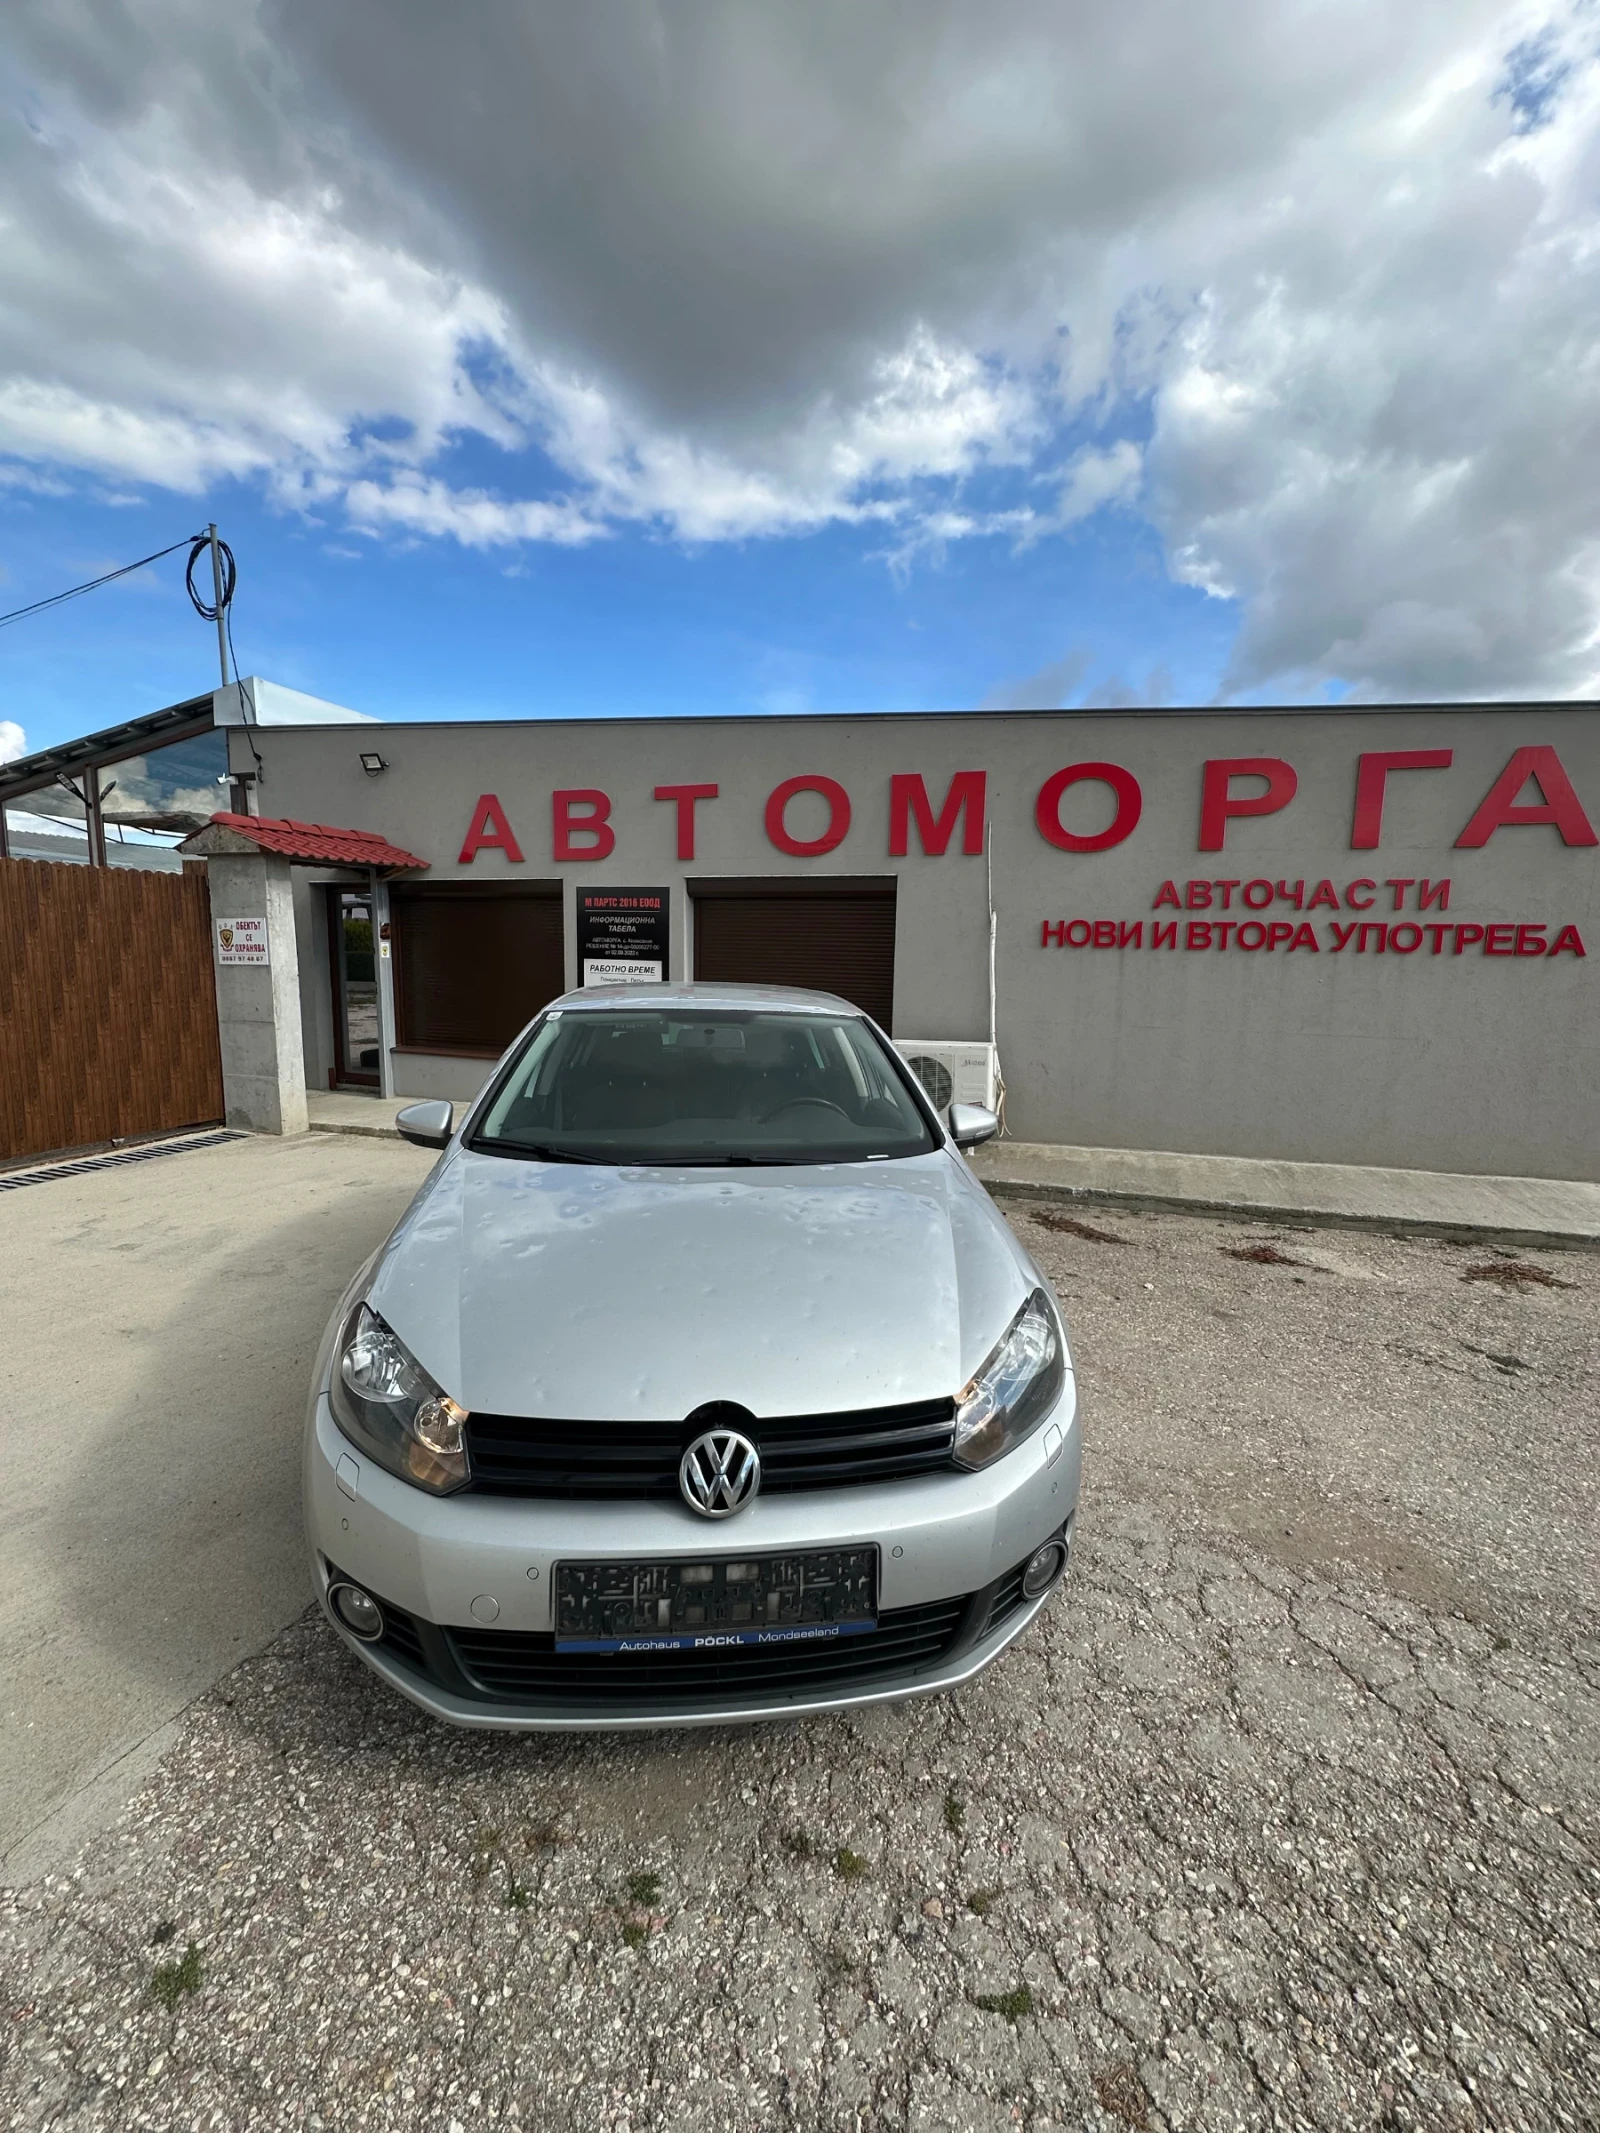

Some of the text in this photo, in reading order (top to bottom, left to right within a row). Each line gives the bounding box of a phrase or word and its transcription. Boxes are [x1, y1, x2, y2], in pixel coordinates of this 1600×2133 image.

[458, 745, 1599, 864] АВТОМОРГА
[1152, 878, 1451, 911] АВТОЧАСТИ
[585, 898, 661, 908] М ПАРТС 2016 ЕООД
[236, 921, 261, 930] ОБЕКТЪТ
[589, 916, 656, 925] ИНФОРМАЦИОННА
[608, 925, 637, 933] ТАБЕЛА
[1041, 919, 1586, 957] НОВИ И ВТОРА УПОТРЕБА
[235, 944, 265, 952] ОХРАНЯВА
[589, 964, 656, 974] РАБОТНО ВРЕМЕ
[619, 1640, 681, 1651] Autohaus
[758, 1626, 840, 1642] Mondseeland
